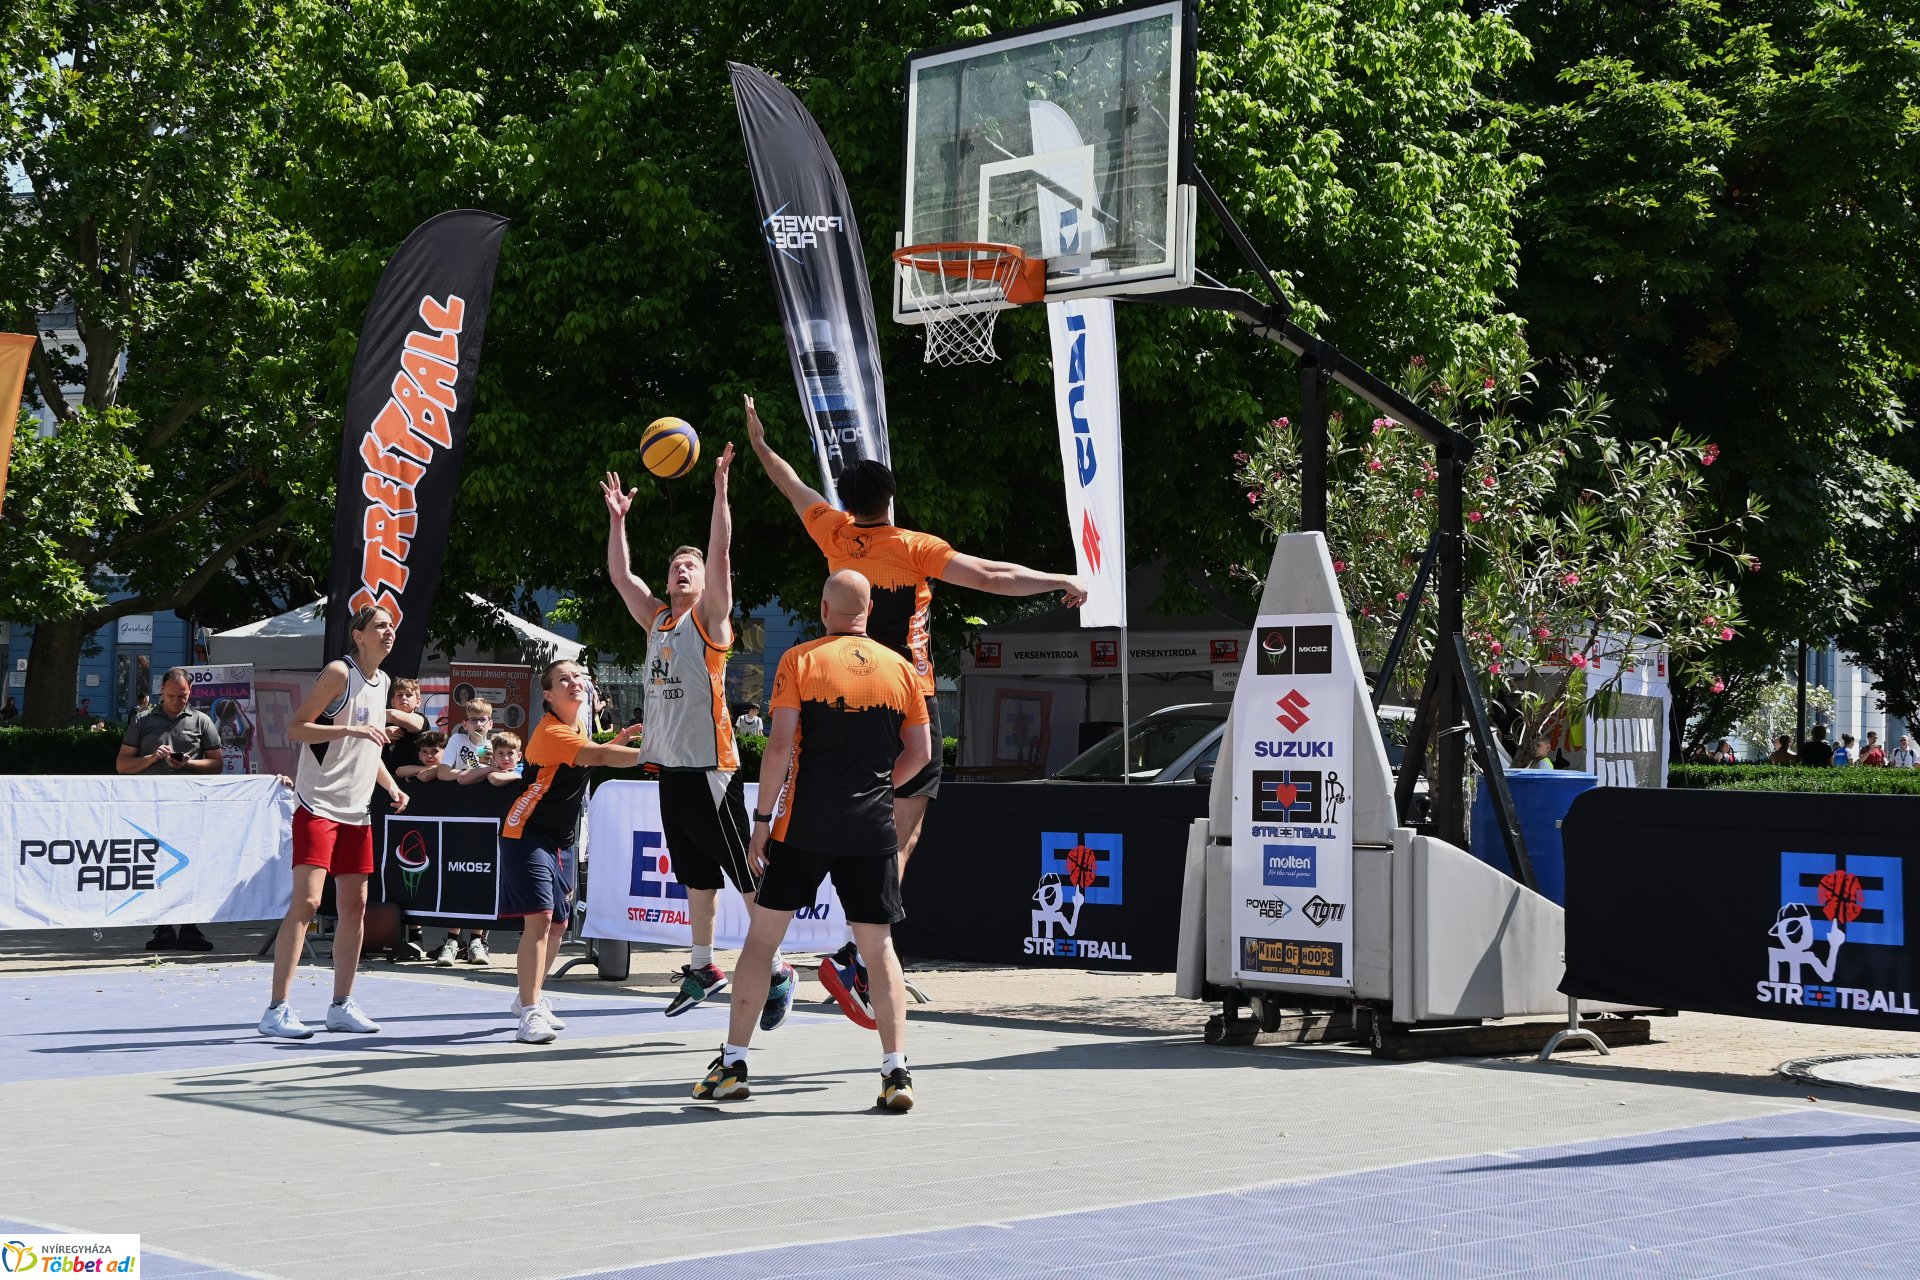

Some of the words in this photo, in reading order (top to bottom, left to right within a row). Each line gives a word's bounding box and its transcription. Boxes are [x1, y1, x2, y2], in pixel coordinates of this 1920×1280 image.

[1014, 651, 1079, 660] VERSENYIRODA
[1129, 648, 1197, 658] VERSENYIRODA
[1298, 645, 1328, 653] MKOSZ
[1254, 740, 1334, 758] SUZUKI
[1251, 826, 1336, 840] STREETBALL
[19, 838, 160, 865] POWER
[447, 860, 491, 874] MKOSZ
[1269, 855, 1311, 869] molten
[77, 864, 155, 892] ADE
[1246, 898, 1284, 910] POWER
[1259, 909, 1284, 919] ADE
[1311, 902, 1346, 922] TOTI
[1023, 936, 1133, 961] STREETBALL
[1259, 942, 1282, 960] KING
[1286, 947, 1298, 961] OF
[1302, 950, 1333, 964] HOOPS
[1261, 965, 1278, 973] SPORTS
[1756, 980, 1920, 1015] STREETBALL
